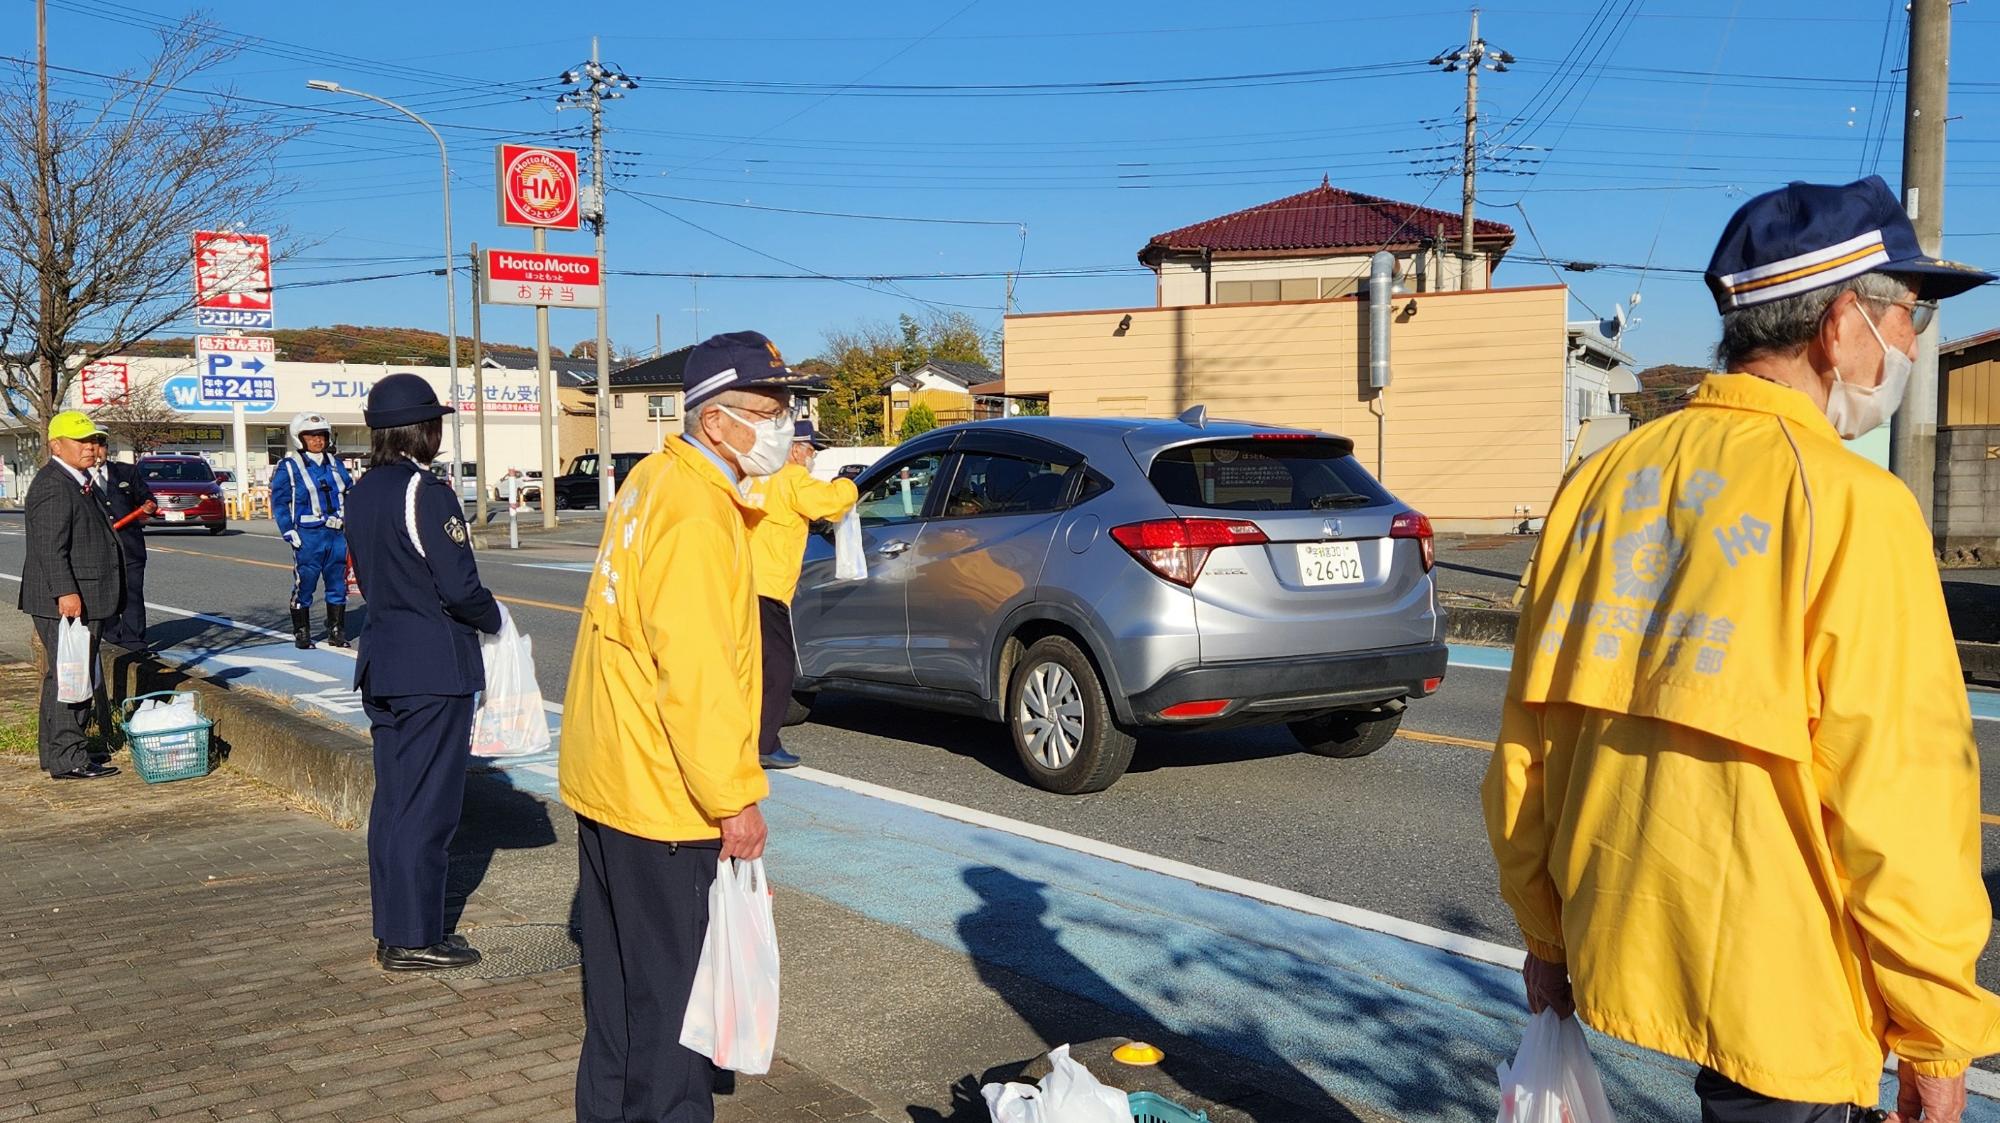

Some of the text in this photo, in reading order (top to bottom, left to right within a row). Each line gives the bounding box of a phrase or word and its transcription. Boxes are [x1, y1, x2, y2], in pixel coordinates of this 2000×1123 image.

[518, 175, 565, 201] HM
[499, 255, 590, 274] HottoMotto
[525, 272, 564, 281] ほっともっと
[518, 284, 575, 302] お弁当
[201, 311, 271, 326] ウエルシア
[200, 338, 272, 351] 処方せん受付
[208, 354, 233, 376] P
[225, 379, 254, 398] 24
[1315, 560, 1360, 581] 26-02
